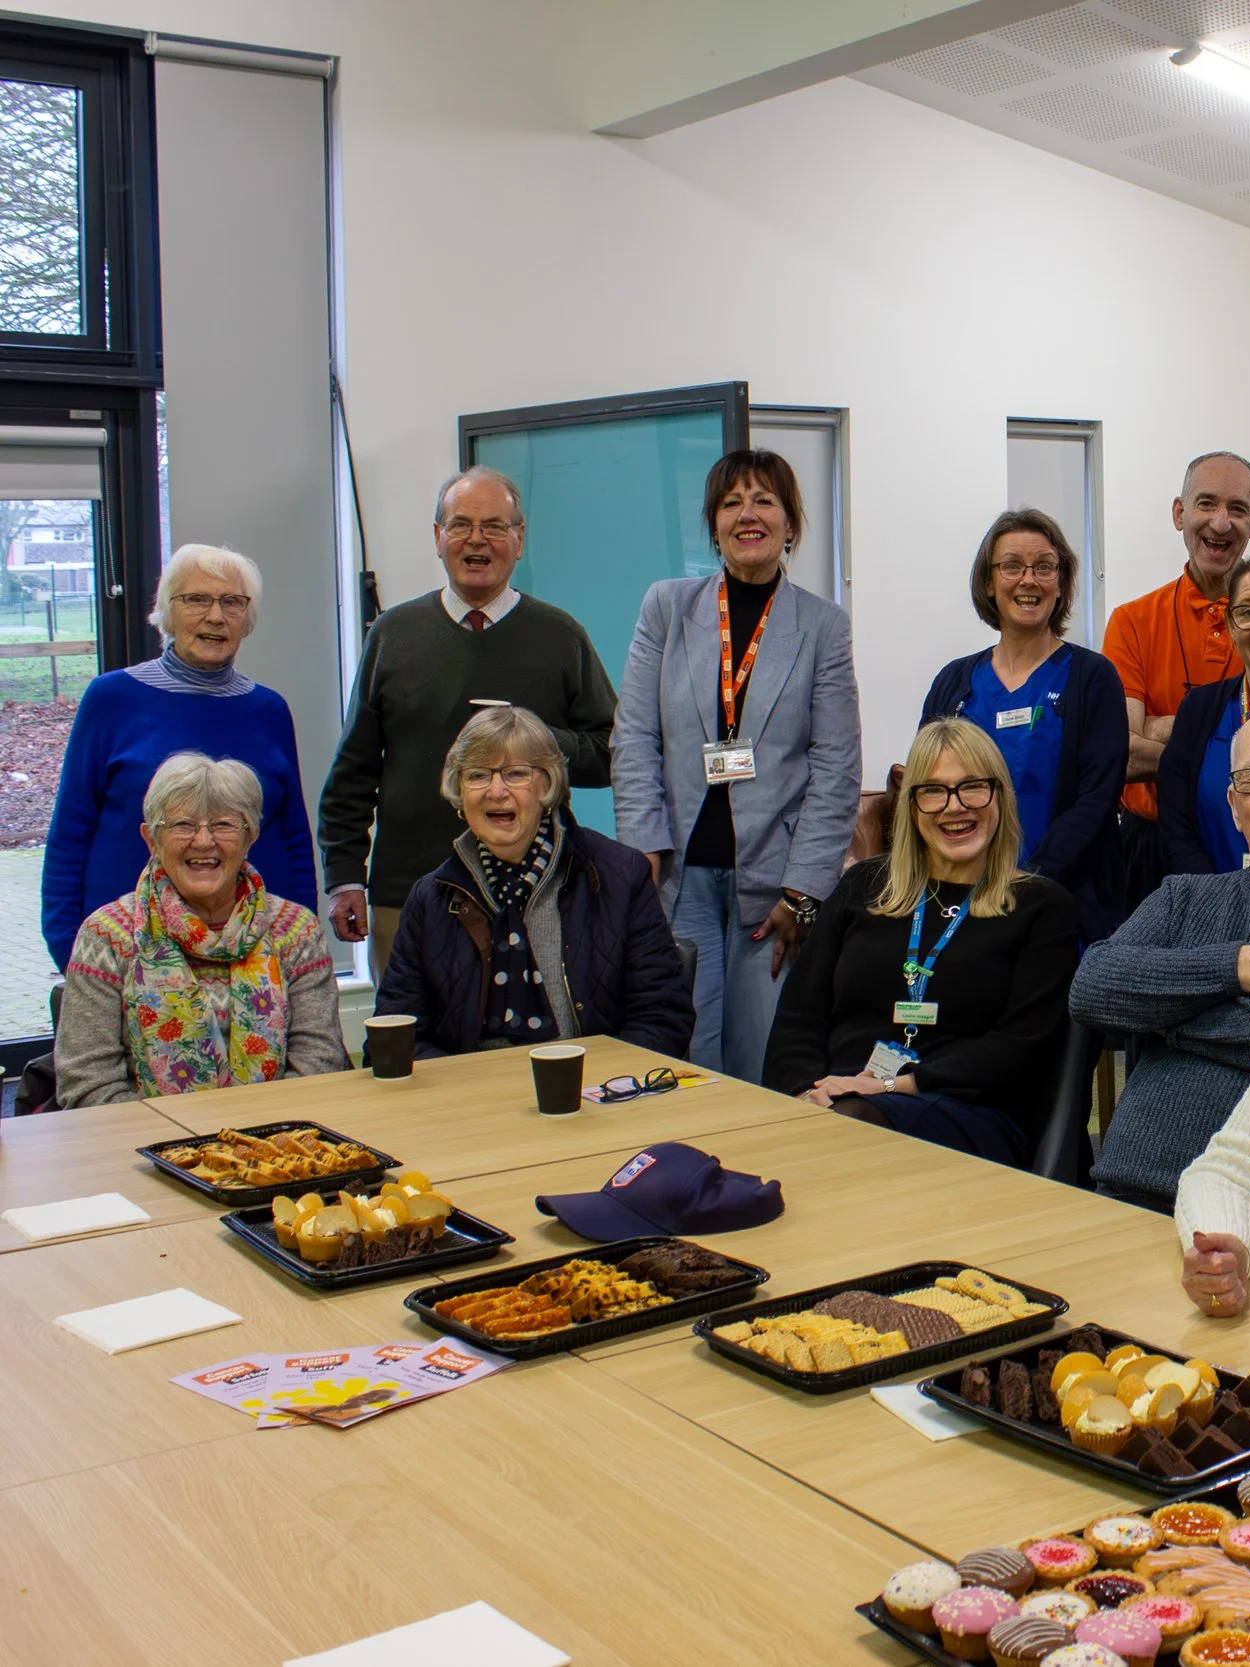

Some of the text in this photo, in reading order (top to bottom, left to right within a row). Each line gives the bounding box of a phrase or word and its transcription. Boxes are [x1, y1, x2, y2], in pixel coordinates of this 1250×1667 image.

[429, 1355, 467, 1370] Support
[443, 1353, 475, 1367] Cancer
[425, 1365, 460, 1379] Suffolk
